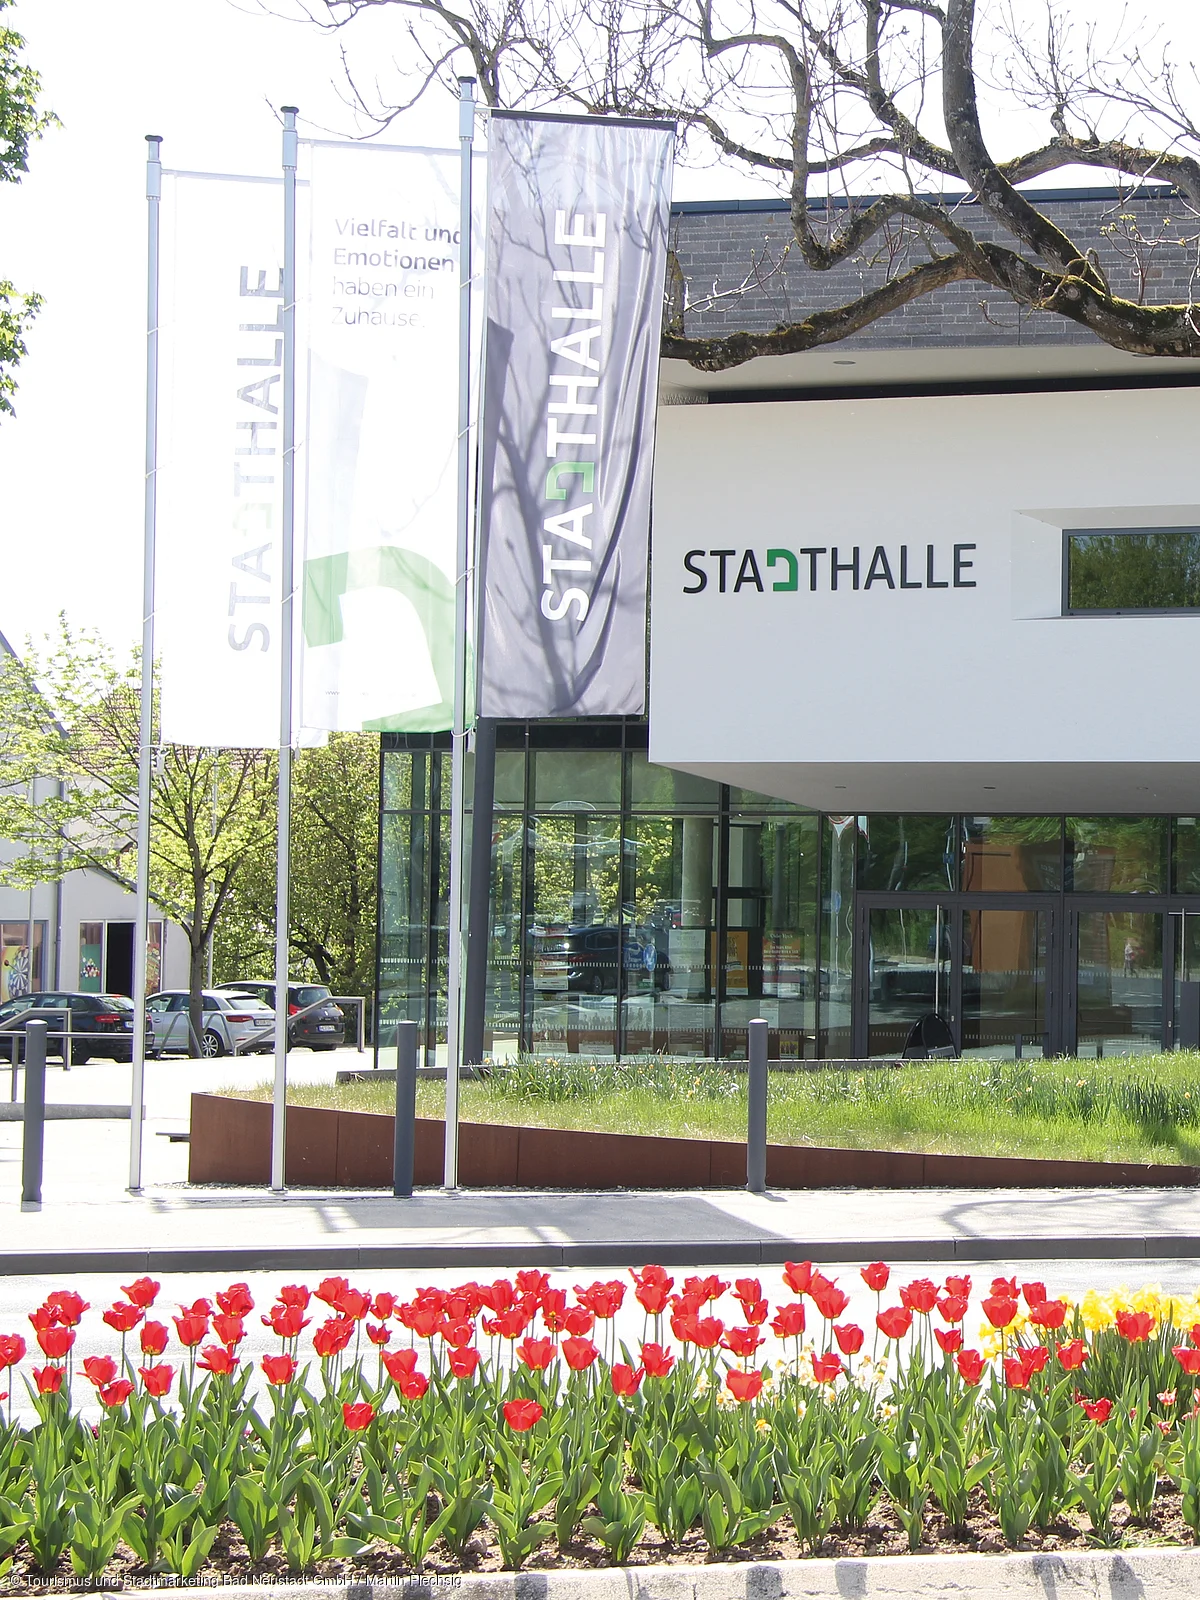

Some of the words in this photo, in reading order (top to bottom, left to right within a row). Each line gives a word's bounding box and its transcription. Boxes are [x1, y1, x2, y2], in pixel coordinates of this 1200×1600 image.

[334, 217, 418, 241] Vielfalt
[333, 247, 455, 273] Emotionen
[332, 275, 398, 297] haben
[403, 280, 434, 300] ein
[331, 306, 426, 328] Zuhause.
[541, 208, 607, 622] STADTHALLE
[227, 265, 285, 653] STADTHALLE
[683, 543, 977, 594] STADTHALLE
